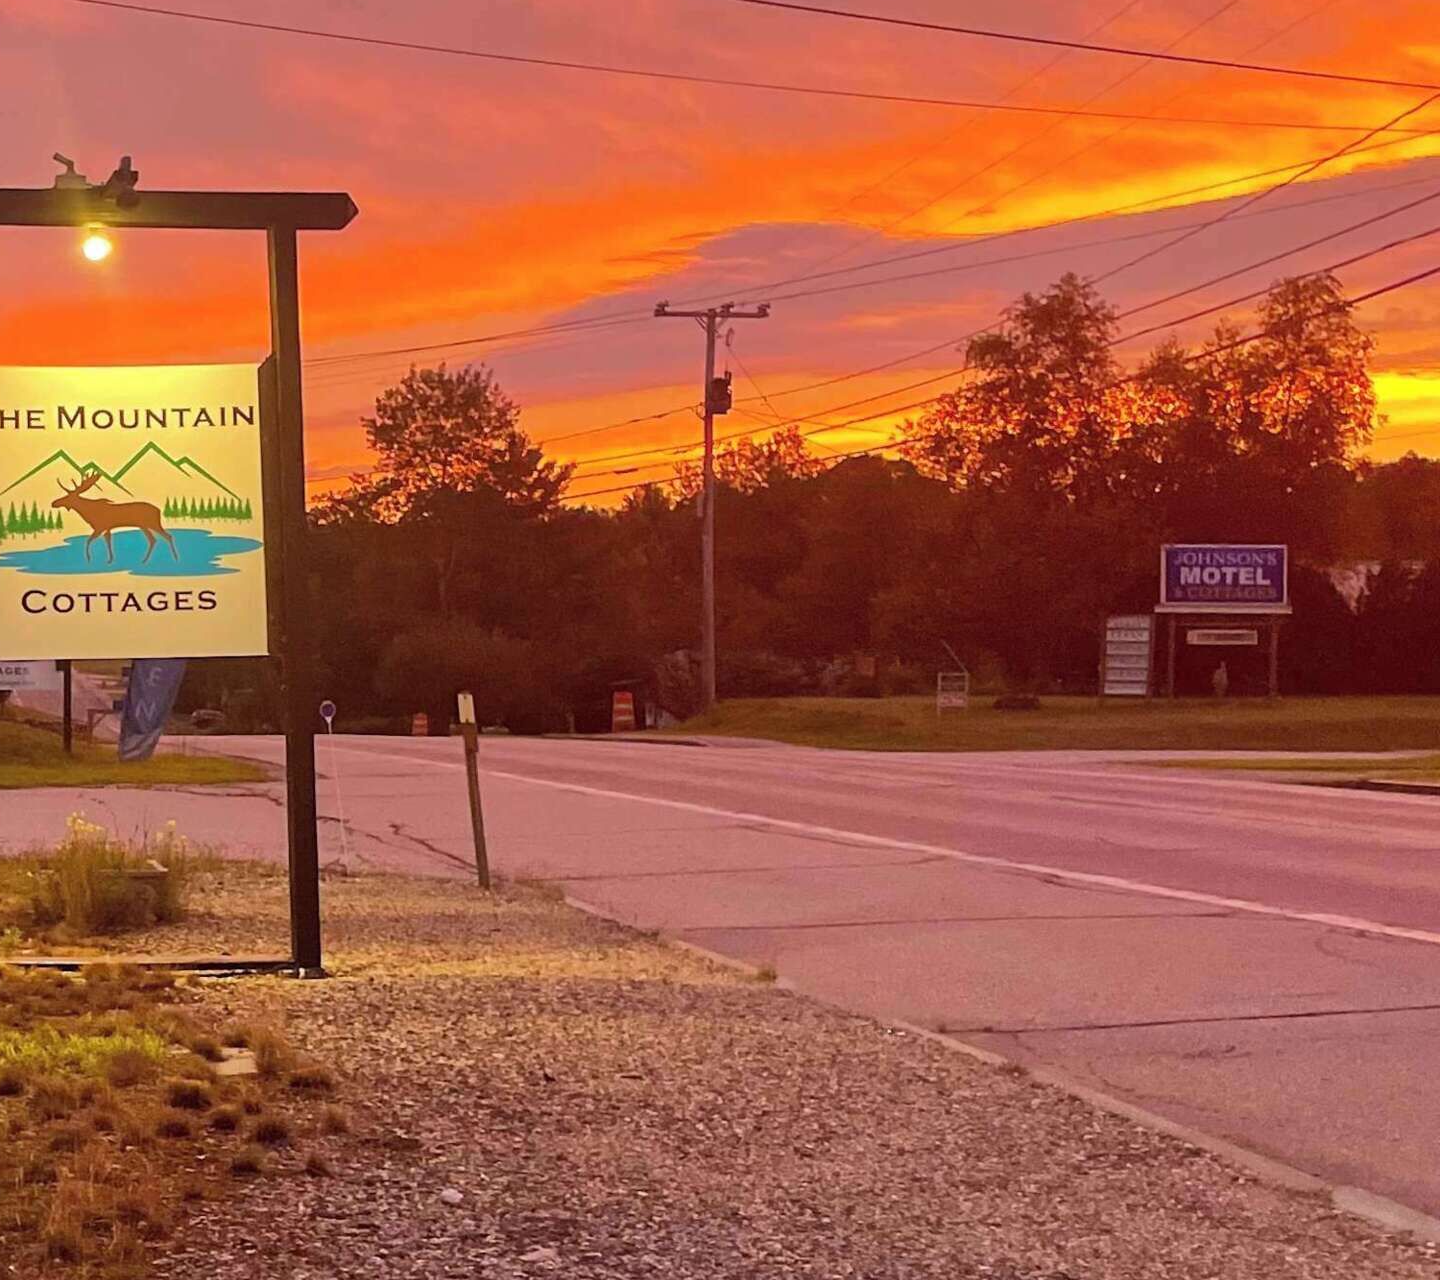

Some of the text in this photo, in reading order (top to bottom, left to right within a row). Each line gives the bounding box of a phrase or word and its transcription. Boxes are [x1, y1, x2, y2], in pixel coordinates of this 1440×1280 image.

[57, 404, 255, 430] MOUNTAIN
[1174, 551, 1277, 566] JOHNSON'S
[1179, 566, 1271, 586] MOTEL
[21, 589, 218, 614] COTTAGES
